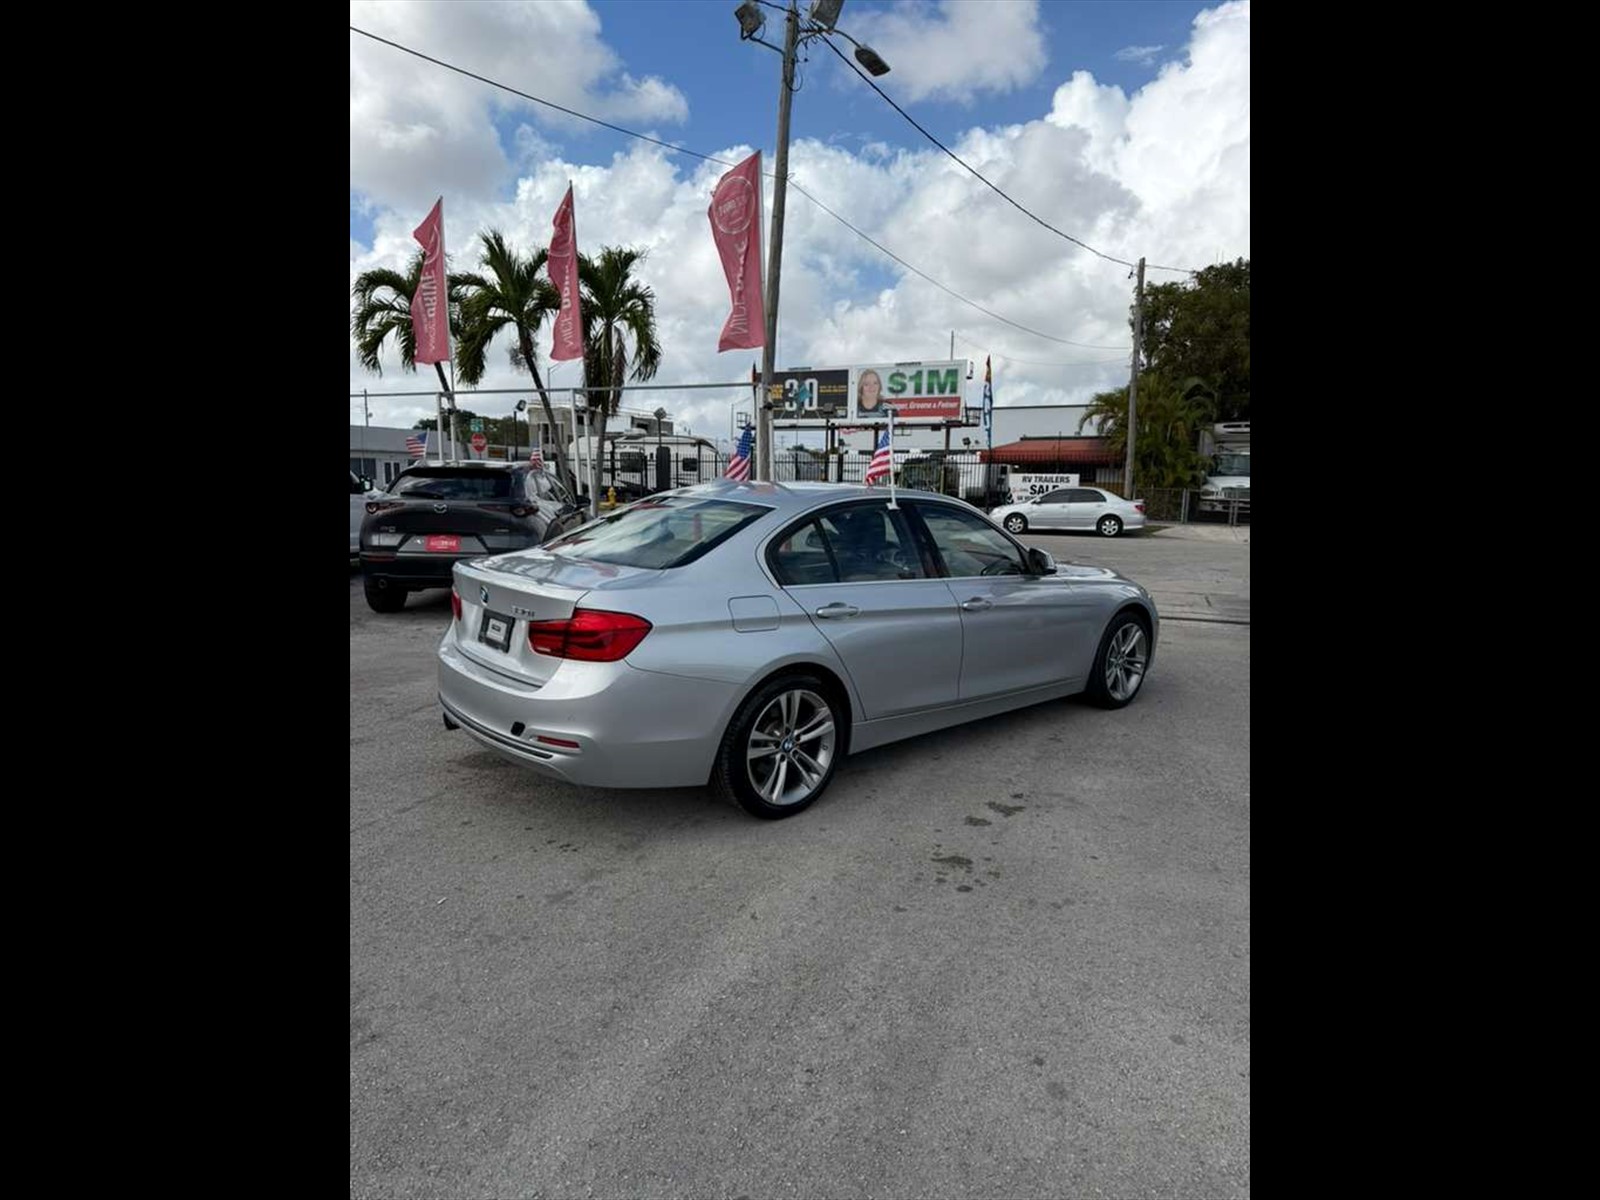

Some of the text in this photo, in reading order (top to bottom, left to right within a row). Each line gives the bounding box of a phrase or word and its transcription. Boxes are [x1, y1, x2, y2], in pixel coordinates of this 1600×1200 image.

[887, 367, 959, 396] $1M
[1022, 475, 1071, 483] RV TRAILERS
